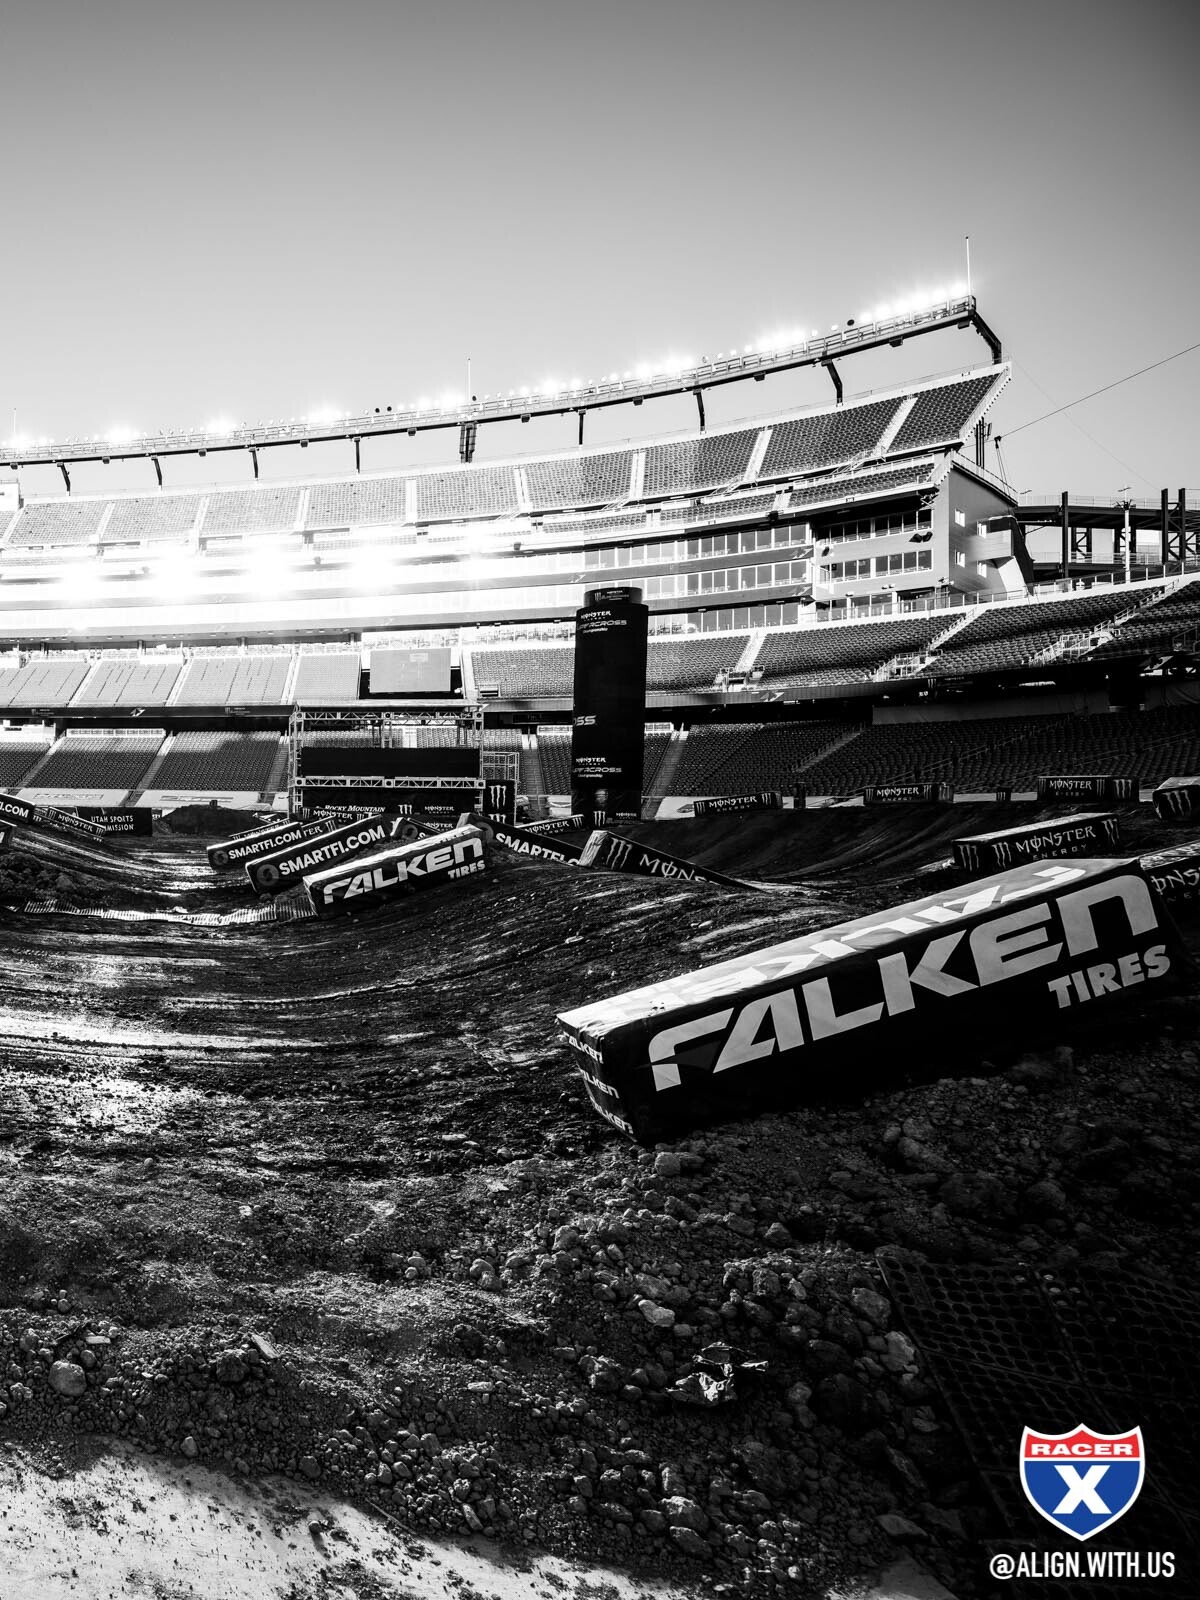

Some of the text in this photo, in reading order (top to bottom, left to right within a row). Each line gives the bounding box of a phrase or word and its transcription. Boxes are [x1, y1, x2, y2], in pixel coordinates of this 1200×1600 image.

[876, 785, 920, 798] MONSTER
[1050, 778, 1093, 790] MONSTER
[709, 795, 758, 809] MONSTER
[91, 815, 134, 823] UTAH SPORTS
[313, 809, 353, 820] MONSTER
[228, 829, 302, 860] SMARTFI.COM
[1015, 825, 1096, 854] MONSTER
[278, 825, 385, 877] SMARTFI.COM
[1032, 843, 1088, 860] ENERGY
[324, 837, 484, 904] FALKEN
[448, 859, 486, 881] TIRES
[648, 874, 1159, 1092] FALKEN
[1048, 945, 1173, 1010] TIRES
